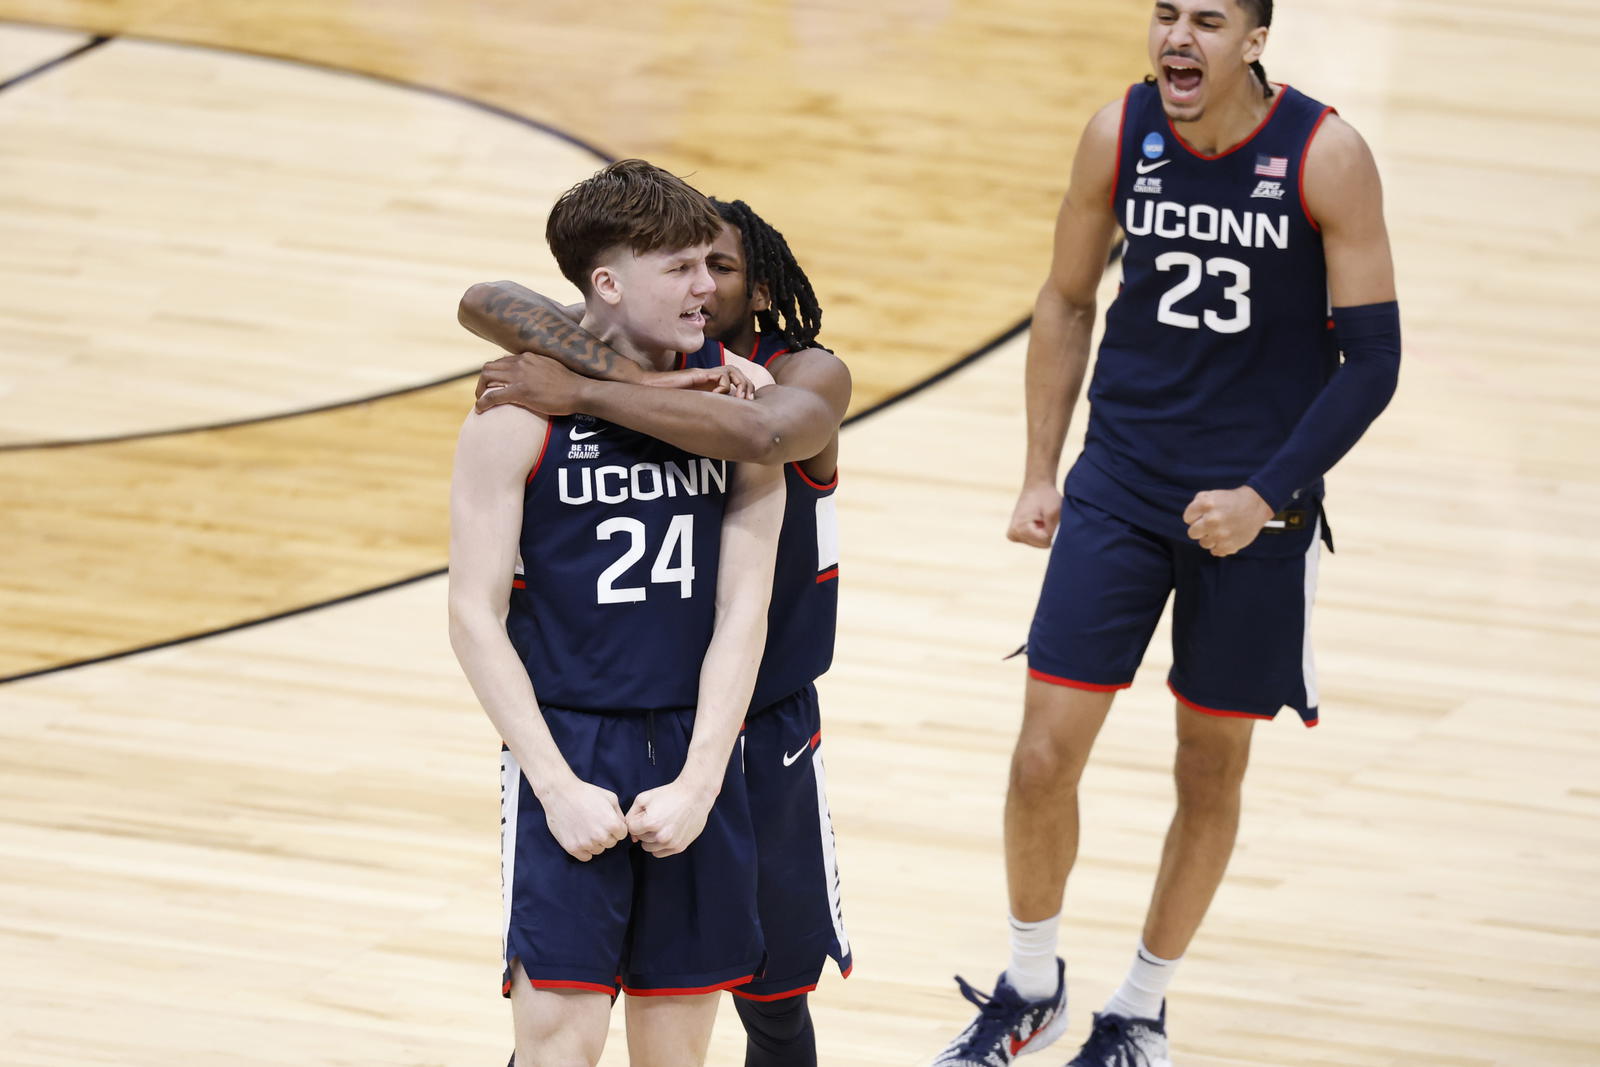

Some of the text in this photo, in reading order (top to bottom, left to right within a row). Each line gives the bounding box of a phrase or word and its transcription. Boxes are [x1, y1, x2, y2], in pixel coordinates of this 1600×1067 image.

[1126, 198, 1289, 249] UCONN
[1155, 252, 1251, 334] 23
[568, 451, 600, 459] CHANGE
[584, 444, 599, 452] THE
[558, 458, 726, 505] UCONN
[596, 514, 695, 604] 24
